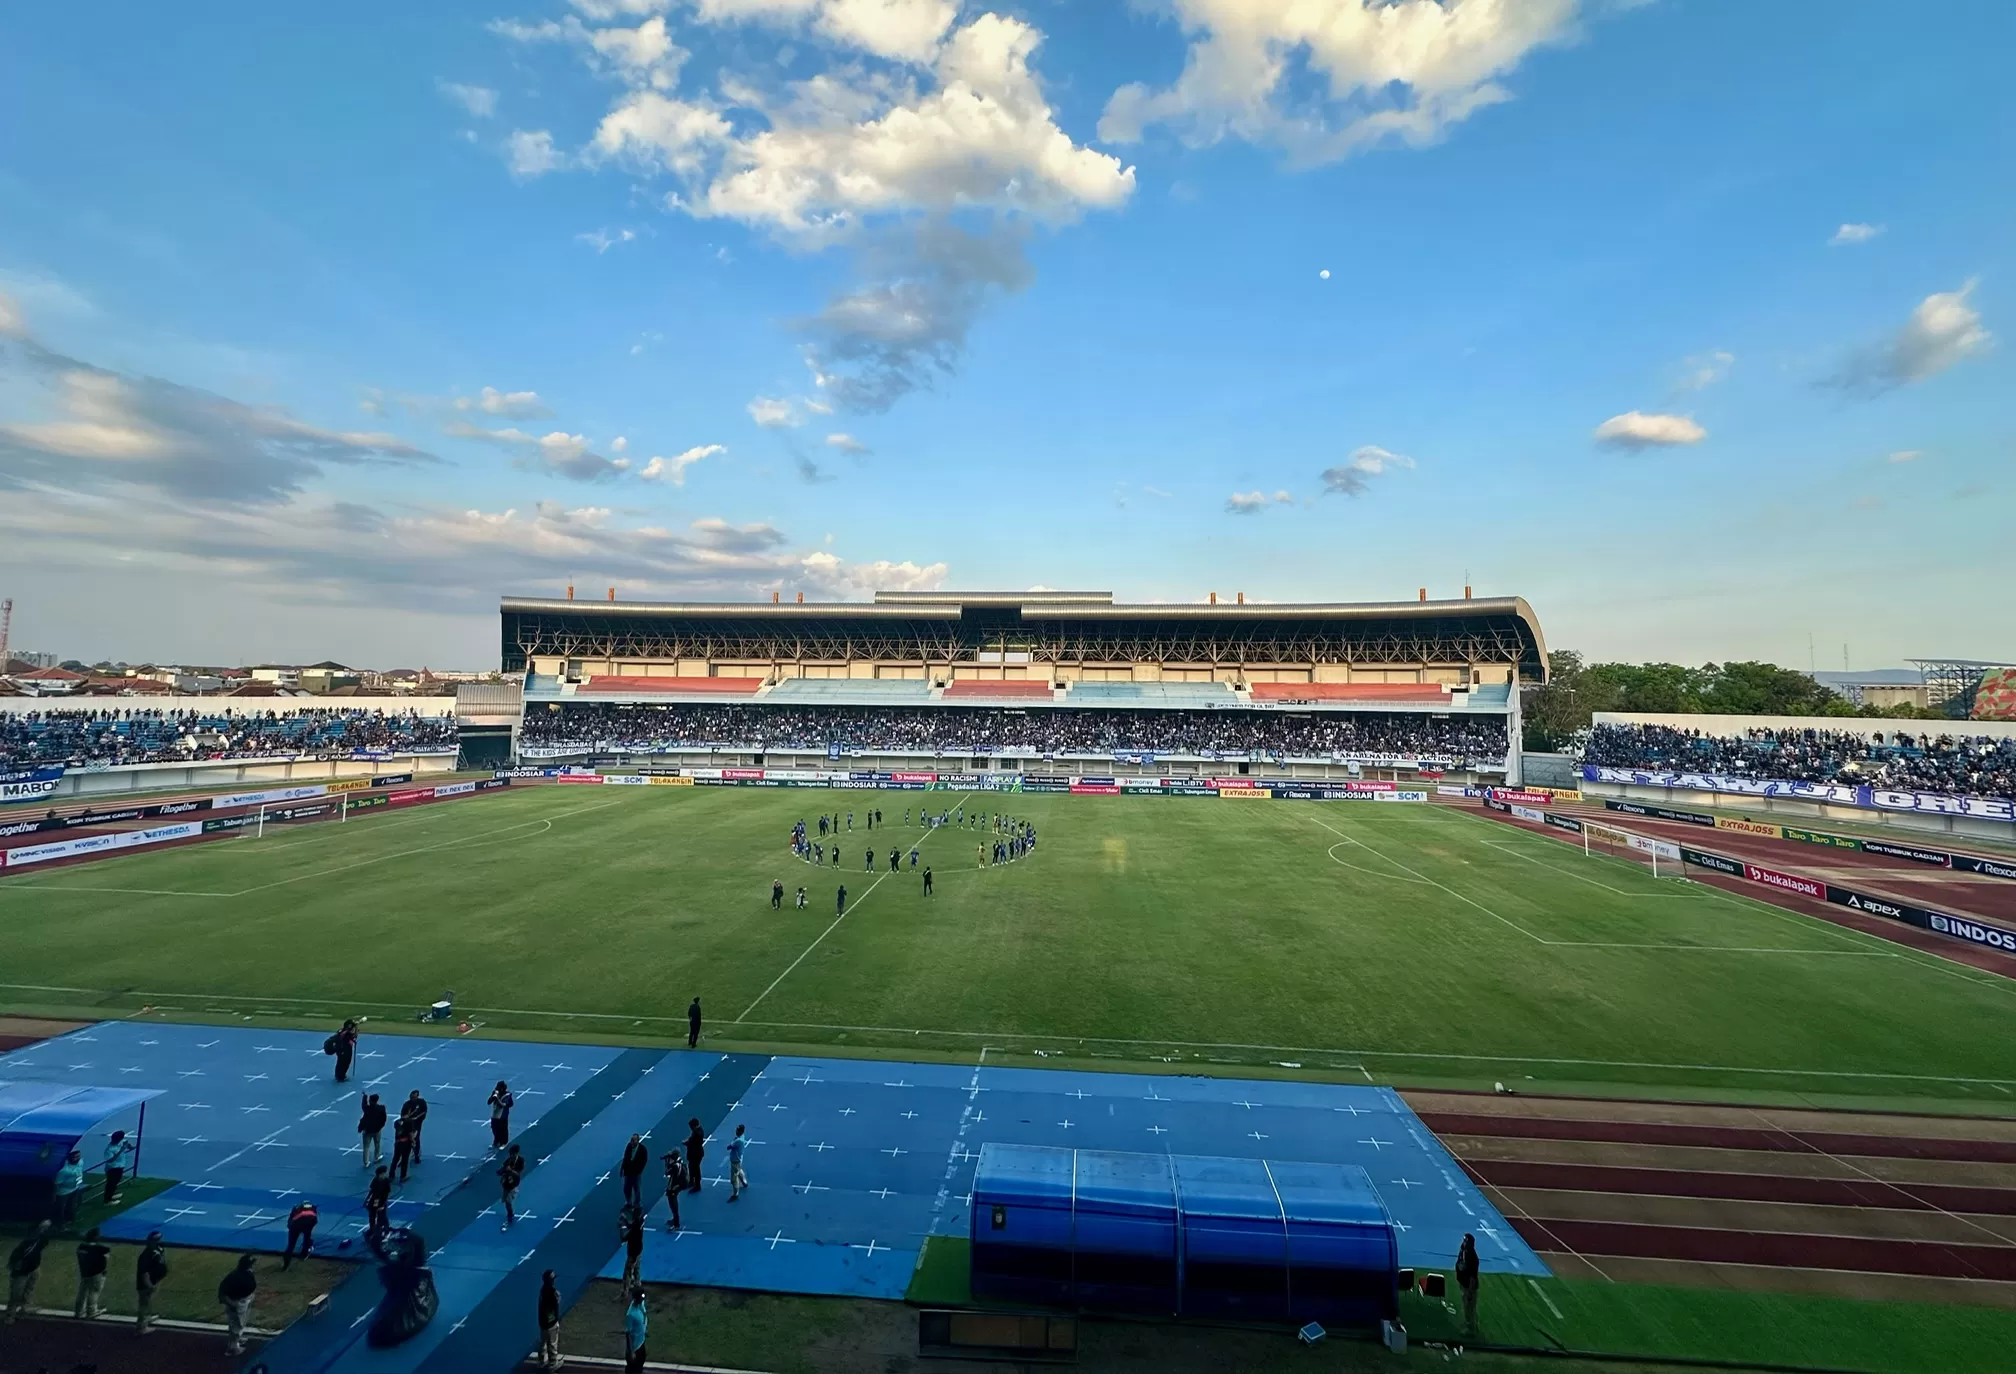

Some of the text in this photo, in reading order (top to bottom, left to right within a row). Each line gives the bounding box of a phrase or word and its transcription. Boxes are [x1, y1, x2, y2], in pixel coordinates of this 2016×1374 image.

[435, 787, 447, 795] nex
[449, 785, 461, 793] nex
[1218, 780, 1249, 788] bukalapak
[1332, 791, 1373, 799] INDOSIAR
[1398, 792, 1420, 800] SCM
[1506, 793, 1546, 802] bukalapak
[1527, 787, 1579, 800] TOLAANGIN
[1622, 804, 1646, 814] Rexona
[1872, 789, 2016, 820] GRE
[223, 818, 254, 826] Tabungan
[1787, 830, 1855, 848] Taro Taro Taro
[1642, 840, 1670, 856] bmney
[1702, 856, 1715, 867] Cicil
[1716, 860, 1734, 871] Emas
[1763, 872, 1818, 896] bukalapak
[1863, 900, 1901, 917] apex
[1950, 920, 2016, 950] INDOS
